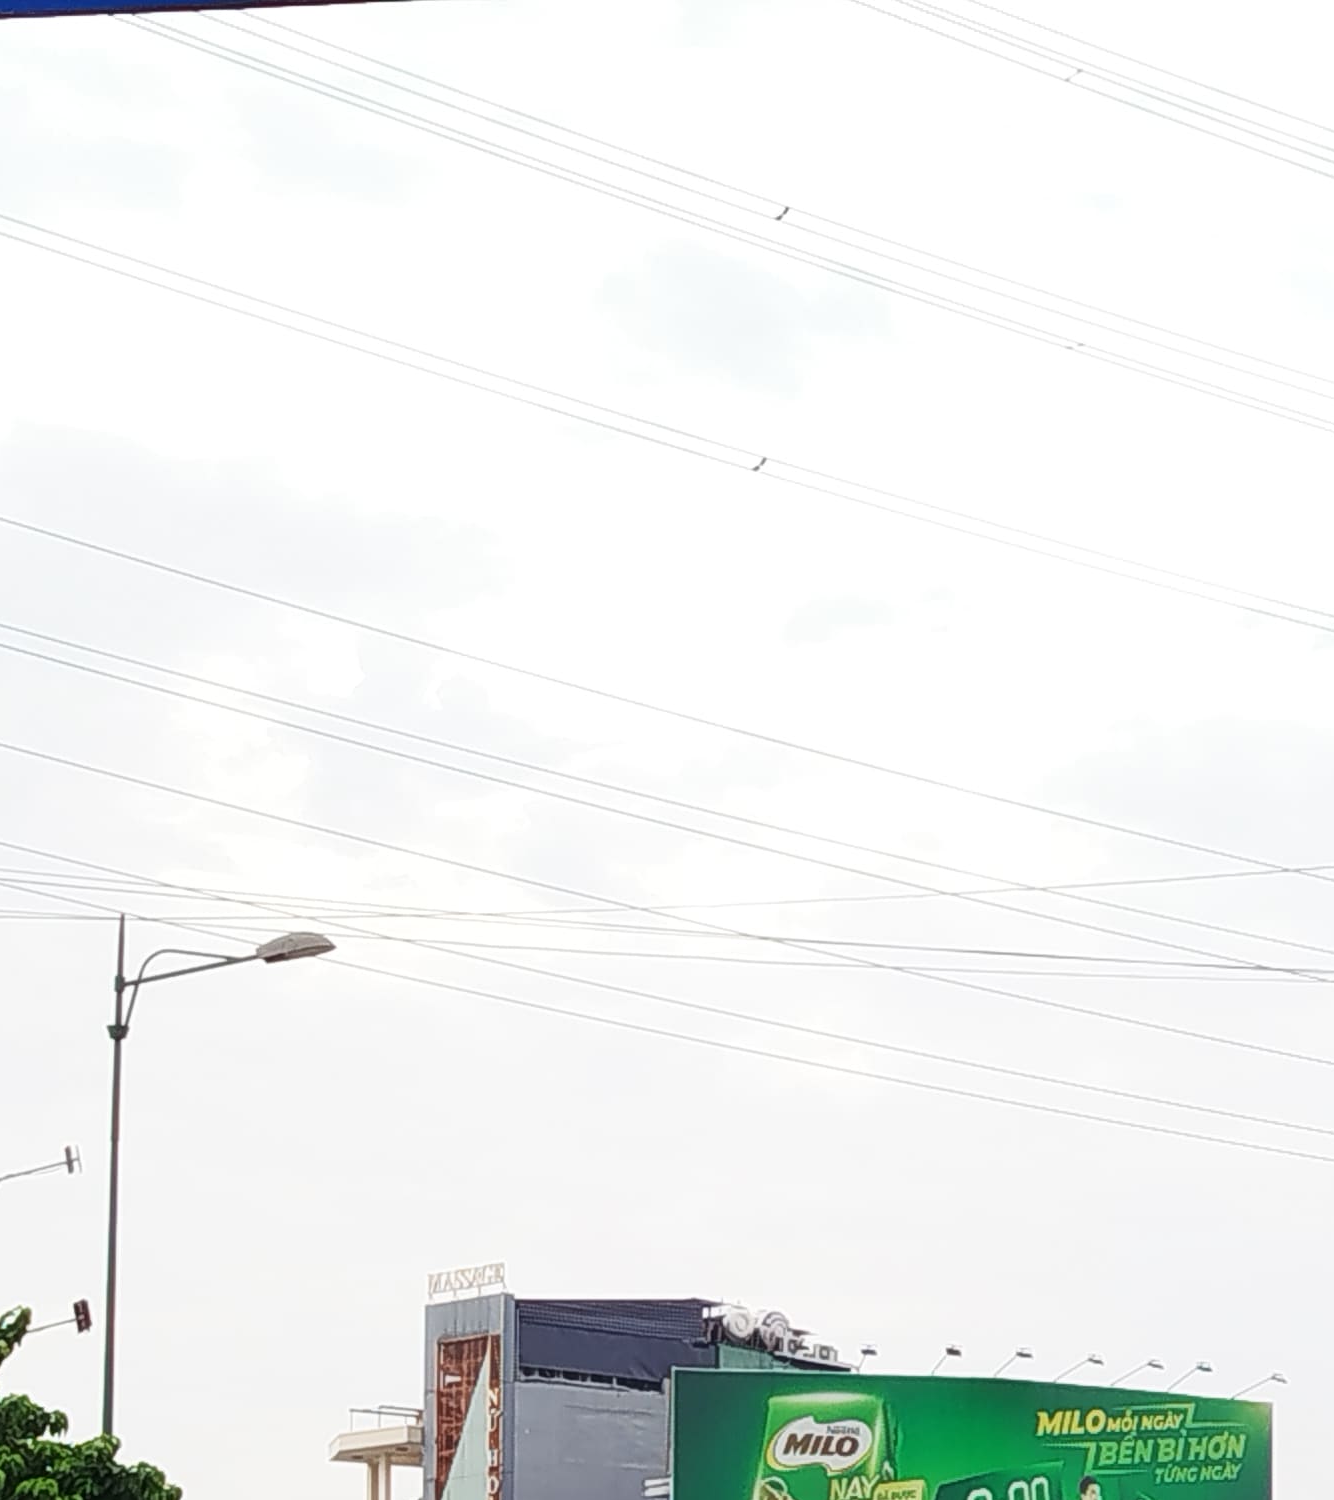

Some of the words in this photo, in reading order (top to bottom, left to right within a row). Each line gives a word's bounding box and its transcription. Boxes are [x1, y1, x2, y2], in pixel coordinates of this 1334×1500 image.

[1036, 1409, 1106, 1437] MILO
[783, 1433, 860, 1457] MILO
[1189, 1431, 1247, 1461] HƠN
